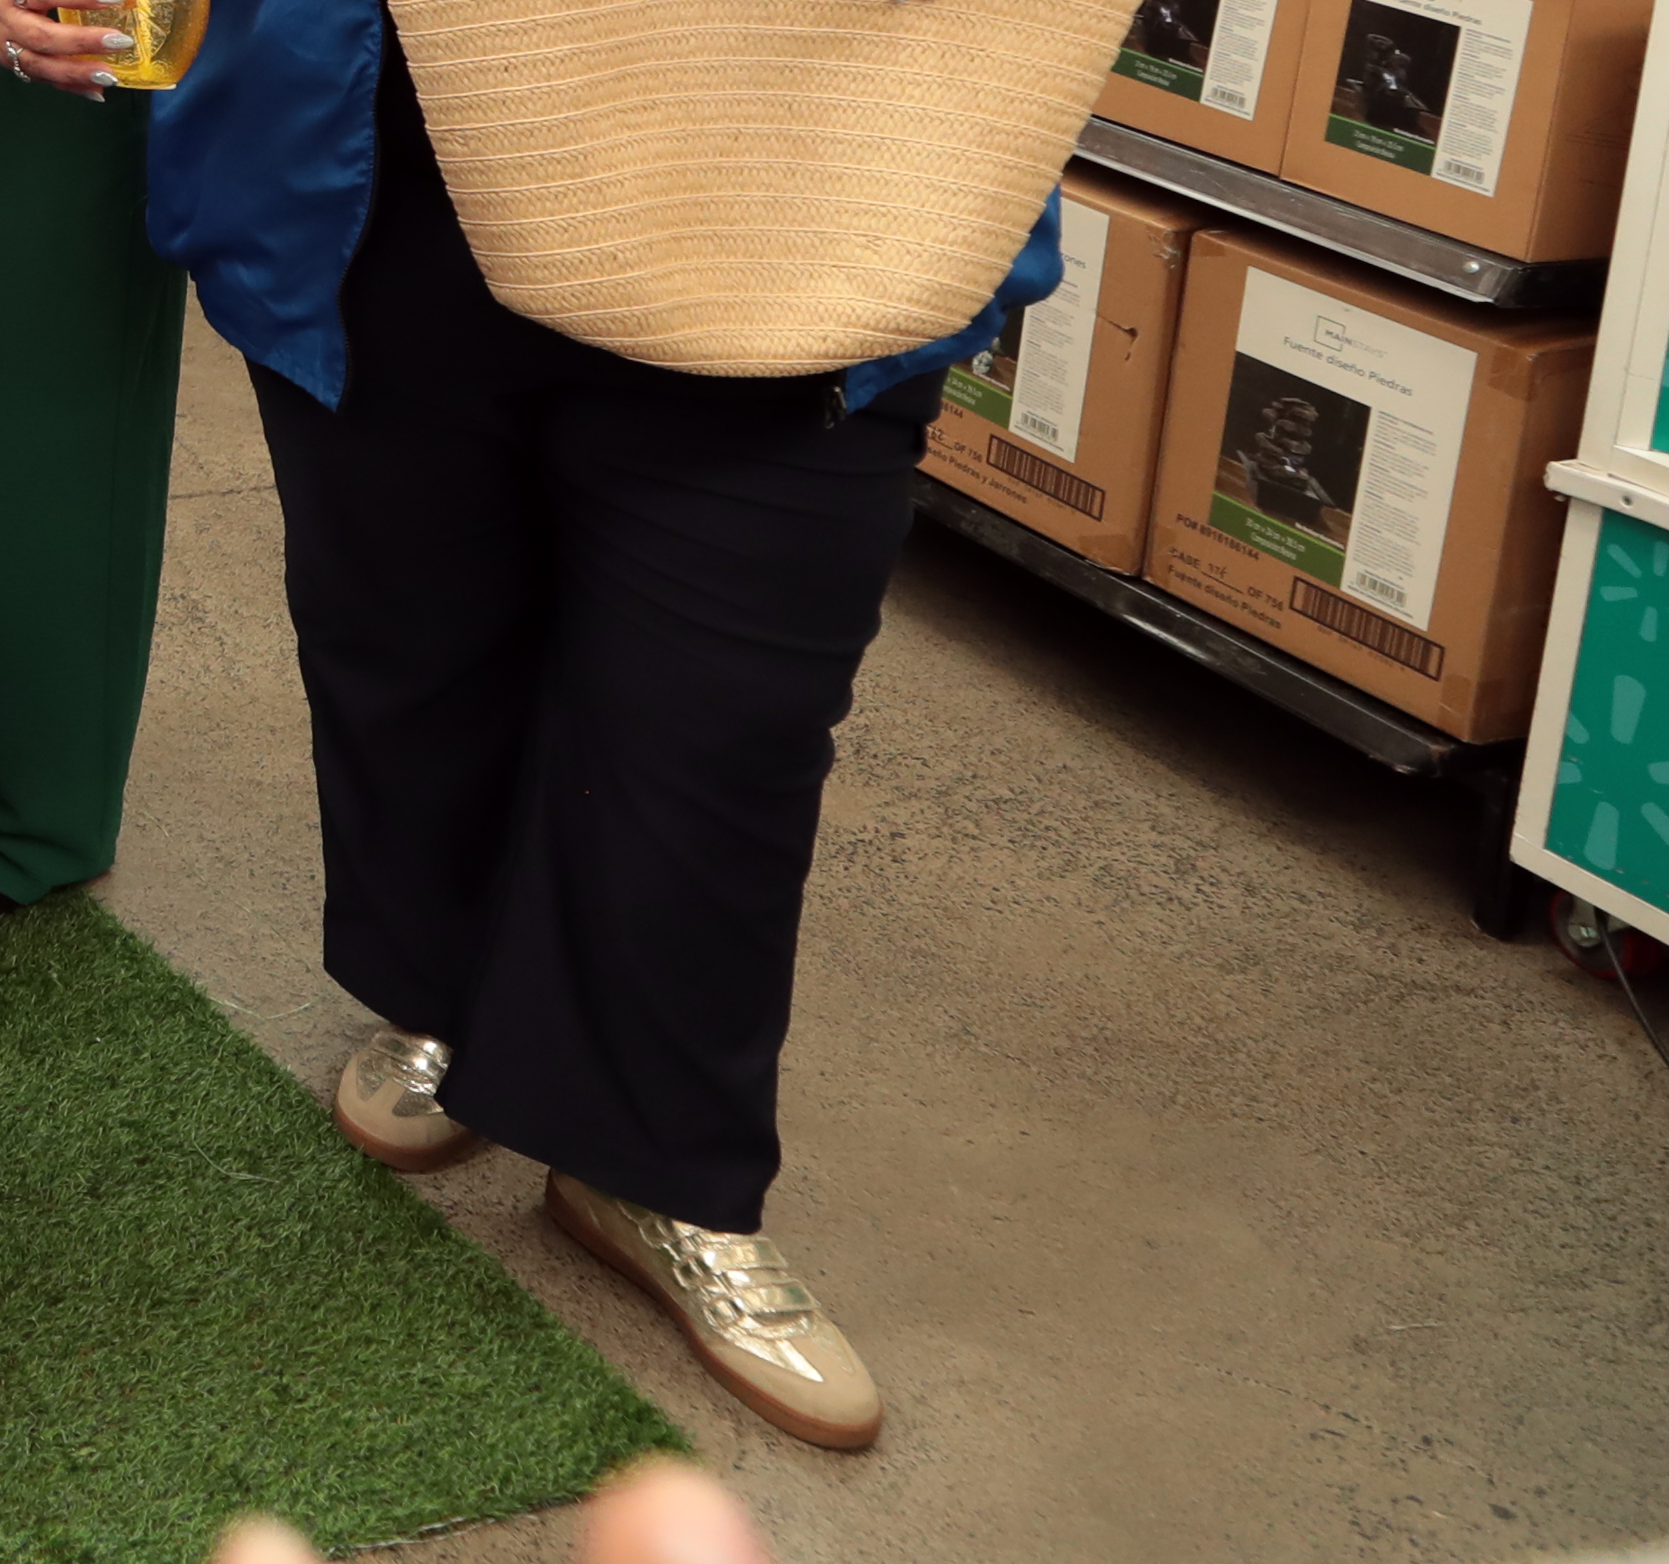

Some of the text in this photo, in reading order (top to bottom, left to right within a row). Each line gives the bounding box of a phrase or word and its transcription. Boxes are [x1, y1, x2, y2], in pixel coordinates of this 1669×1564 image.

[1283, 335, 1414, 397] Fuente diseño Piedras
[948, 455, 981, 481] Piedras
[988, 477, 1028, 505] Jarrones
[1167, 564, 1204, 590] Fuente
[1241, 601, 1282, 630] Piedras
